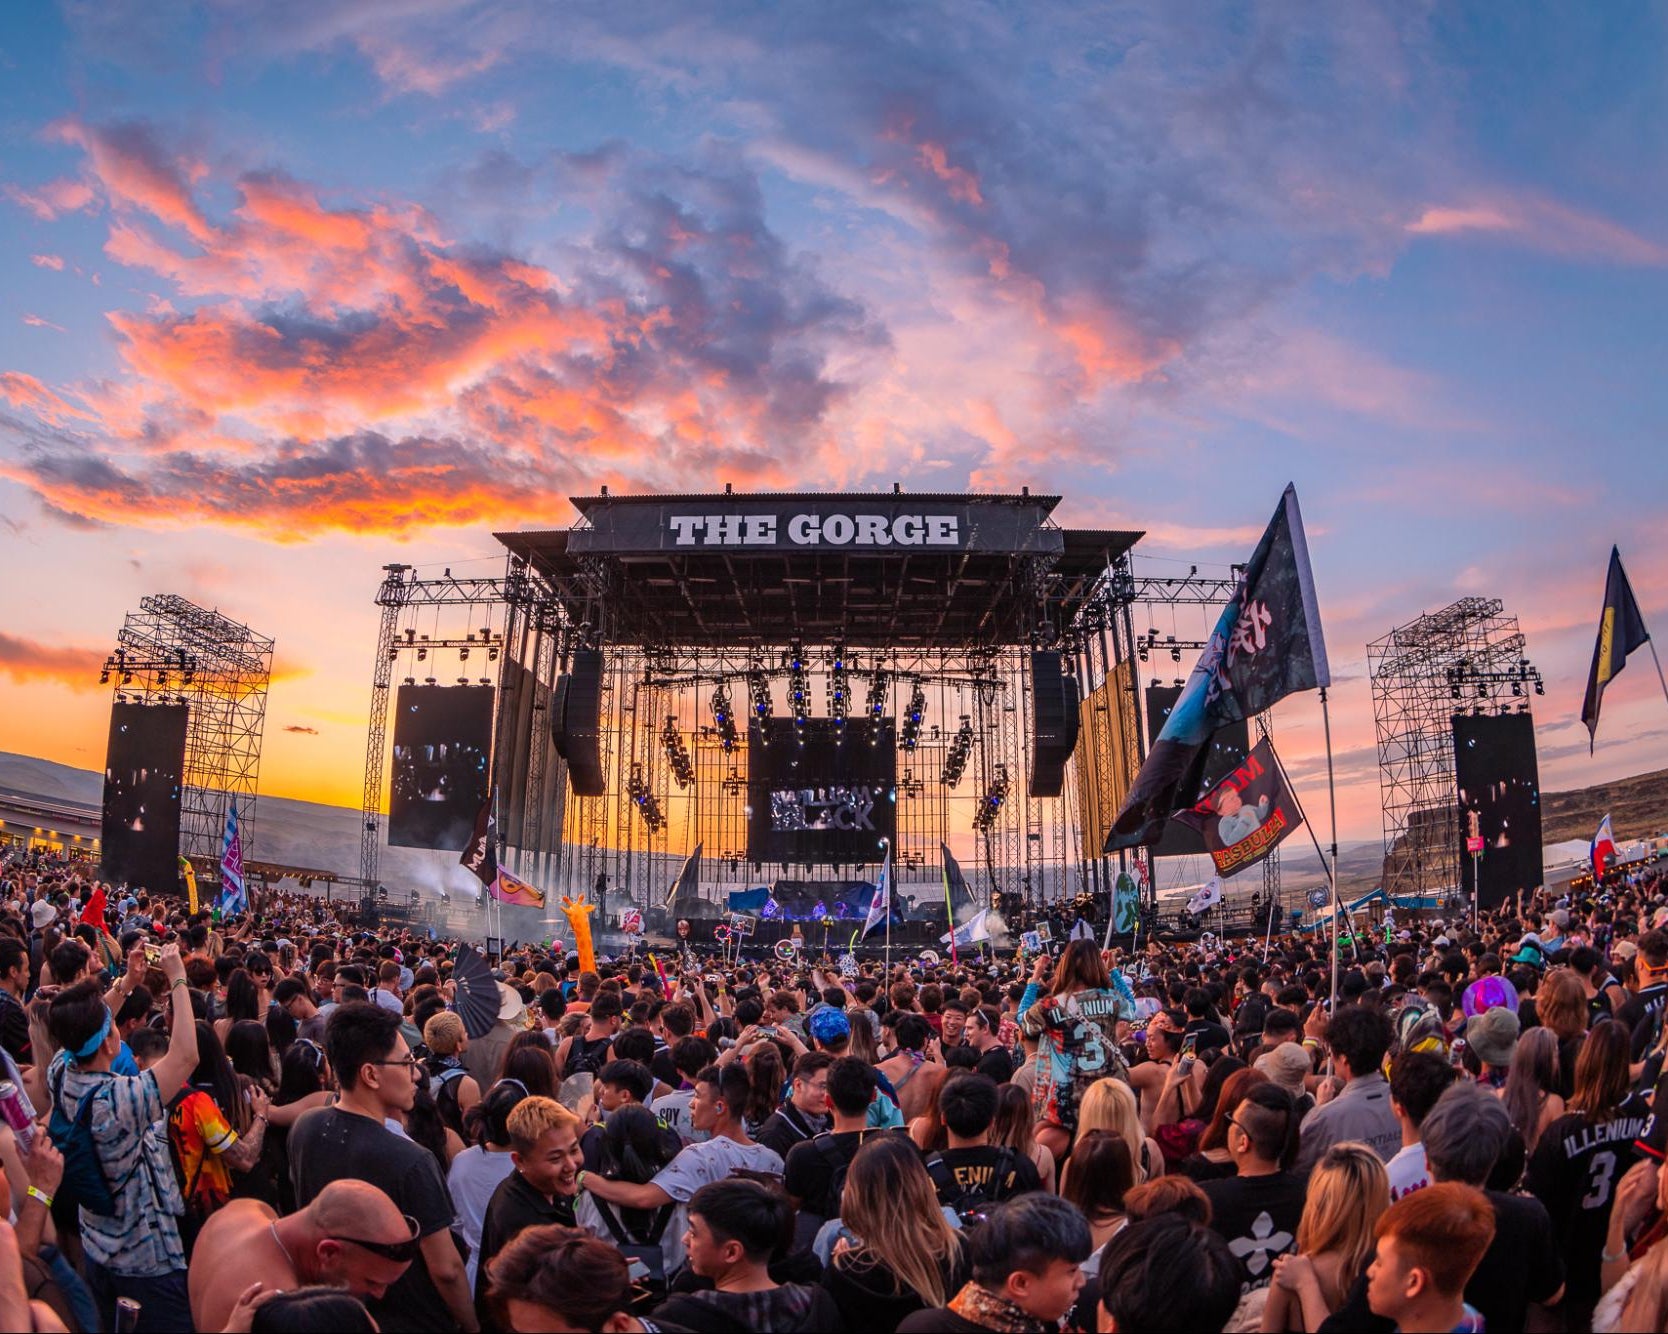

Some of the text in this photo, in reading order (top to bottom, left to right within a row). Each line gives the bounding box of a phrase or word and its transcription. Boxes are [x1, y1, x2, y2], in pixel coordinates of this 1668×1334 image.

[670, 514, 959, 546] THE GORGE
[1051, 999, 1115, 1024] ILNIUM
[1073, 1021, 1106, 1072] 3
[1564, 1118, 1643, 1159] ILLENIUM
[1640, 1112, 1656, 1138] 3
[1582, 1150, 1617, 1209] 3
